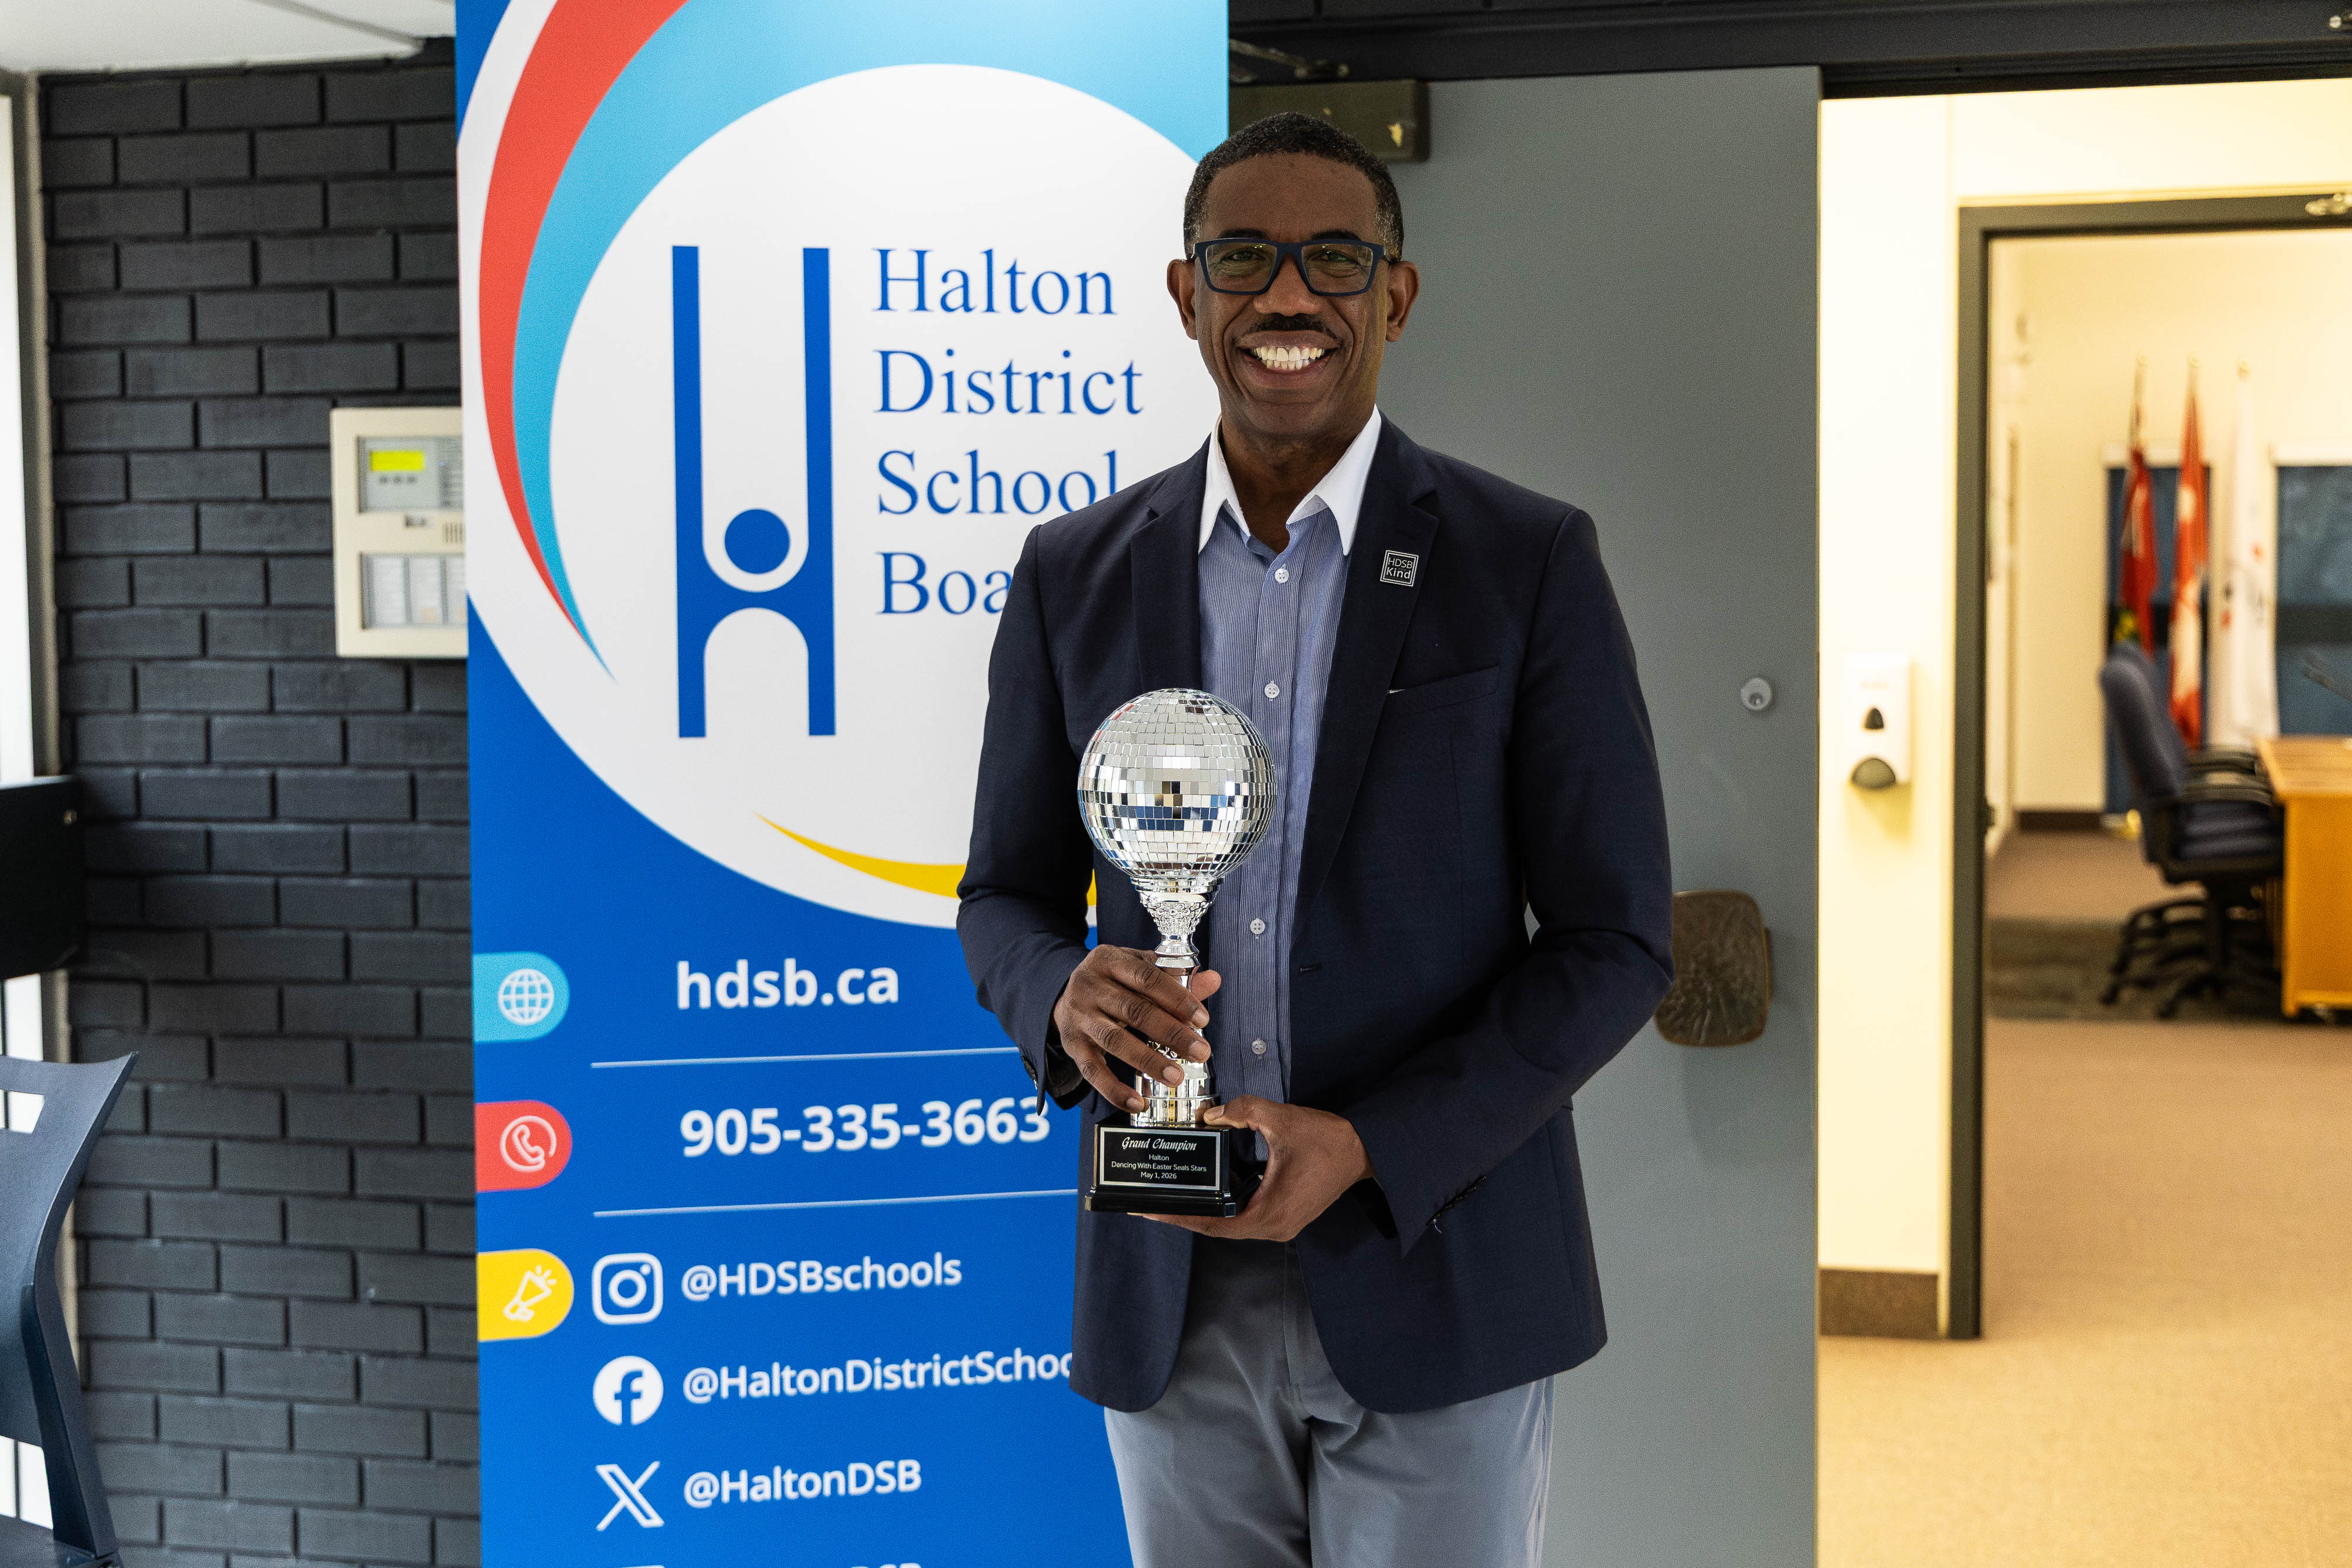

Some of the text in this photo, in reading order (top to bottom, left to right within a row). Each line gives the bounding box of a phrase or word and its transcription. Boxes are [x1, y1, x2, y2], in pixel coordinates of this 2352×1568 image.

[873, 248, 1117, 315] Halton
[874, 348, 1144, 415] District
[877, 449, 1117, 515] School
[1386, 567, 1411, 579] Kind
[1388, 557, 1413, 569] HDSB
[677, 958, 900, 1009] hdsb.ca
[680, 1095, 1051, 1157] 905-335-3663
[1122, 1136, 1197, 1152] Grand Champion
[1111, 1161, 1136, 1169] Dancing
[681, 1252, 963, 1301] @HDSBschools
[683, 1459, 922, 1509] @HaltonDSB
